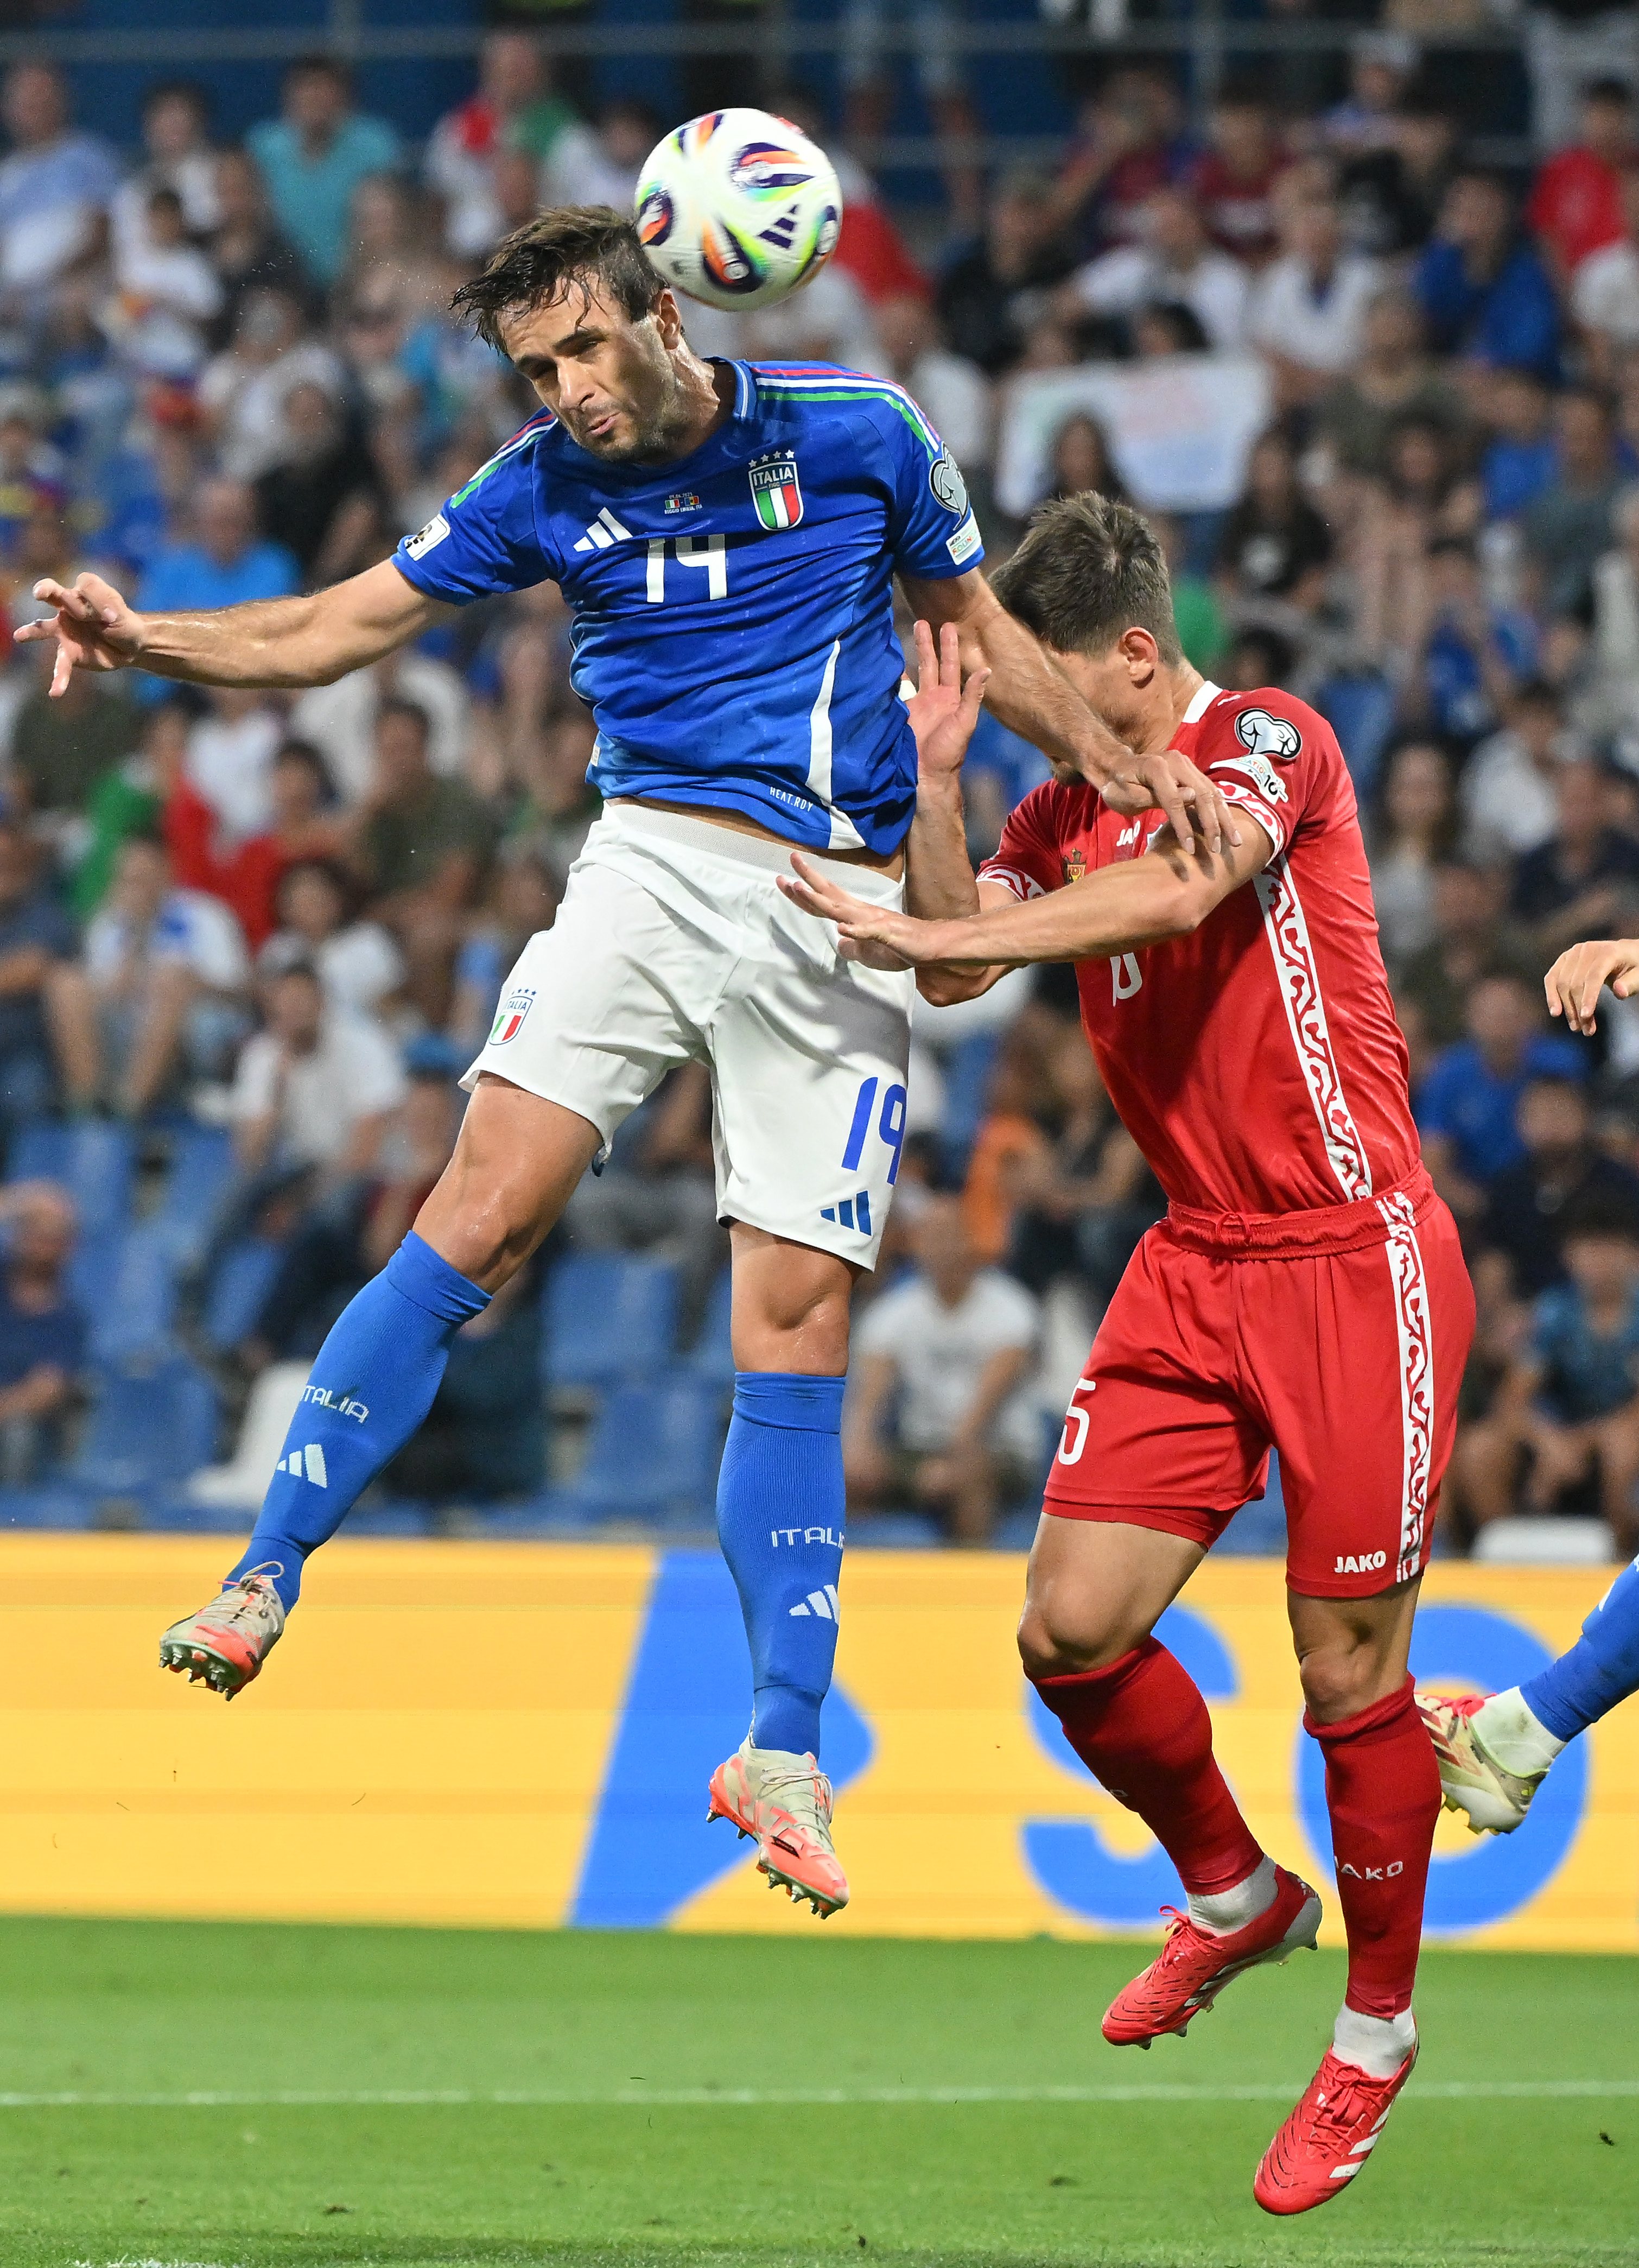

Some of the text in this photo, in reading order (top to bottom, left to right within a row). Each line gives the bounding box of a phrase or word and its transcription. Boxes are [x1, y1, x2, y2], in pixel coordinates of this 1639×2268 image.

[753, 467, 793, 486] ITALIA
[770, 787, 814, 812] HEAT.RDY
[1116, 820, 1141, 847] JAO
[841, 1076, 907, 1186] 19
[1334, 1550, 1387, 1573] JAKO
